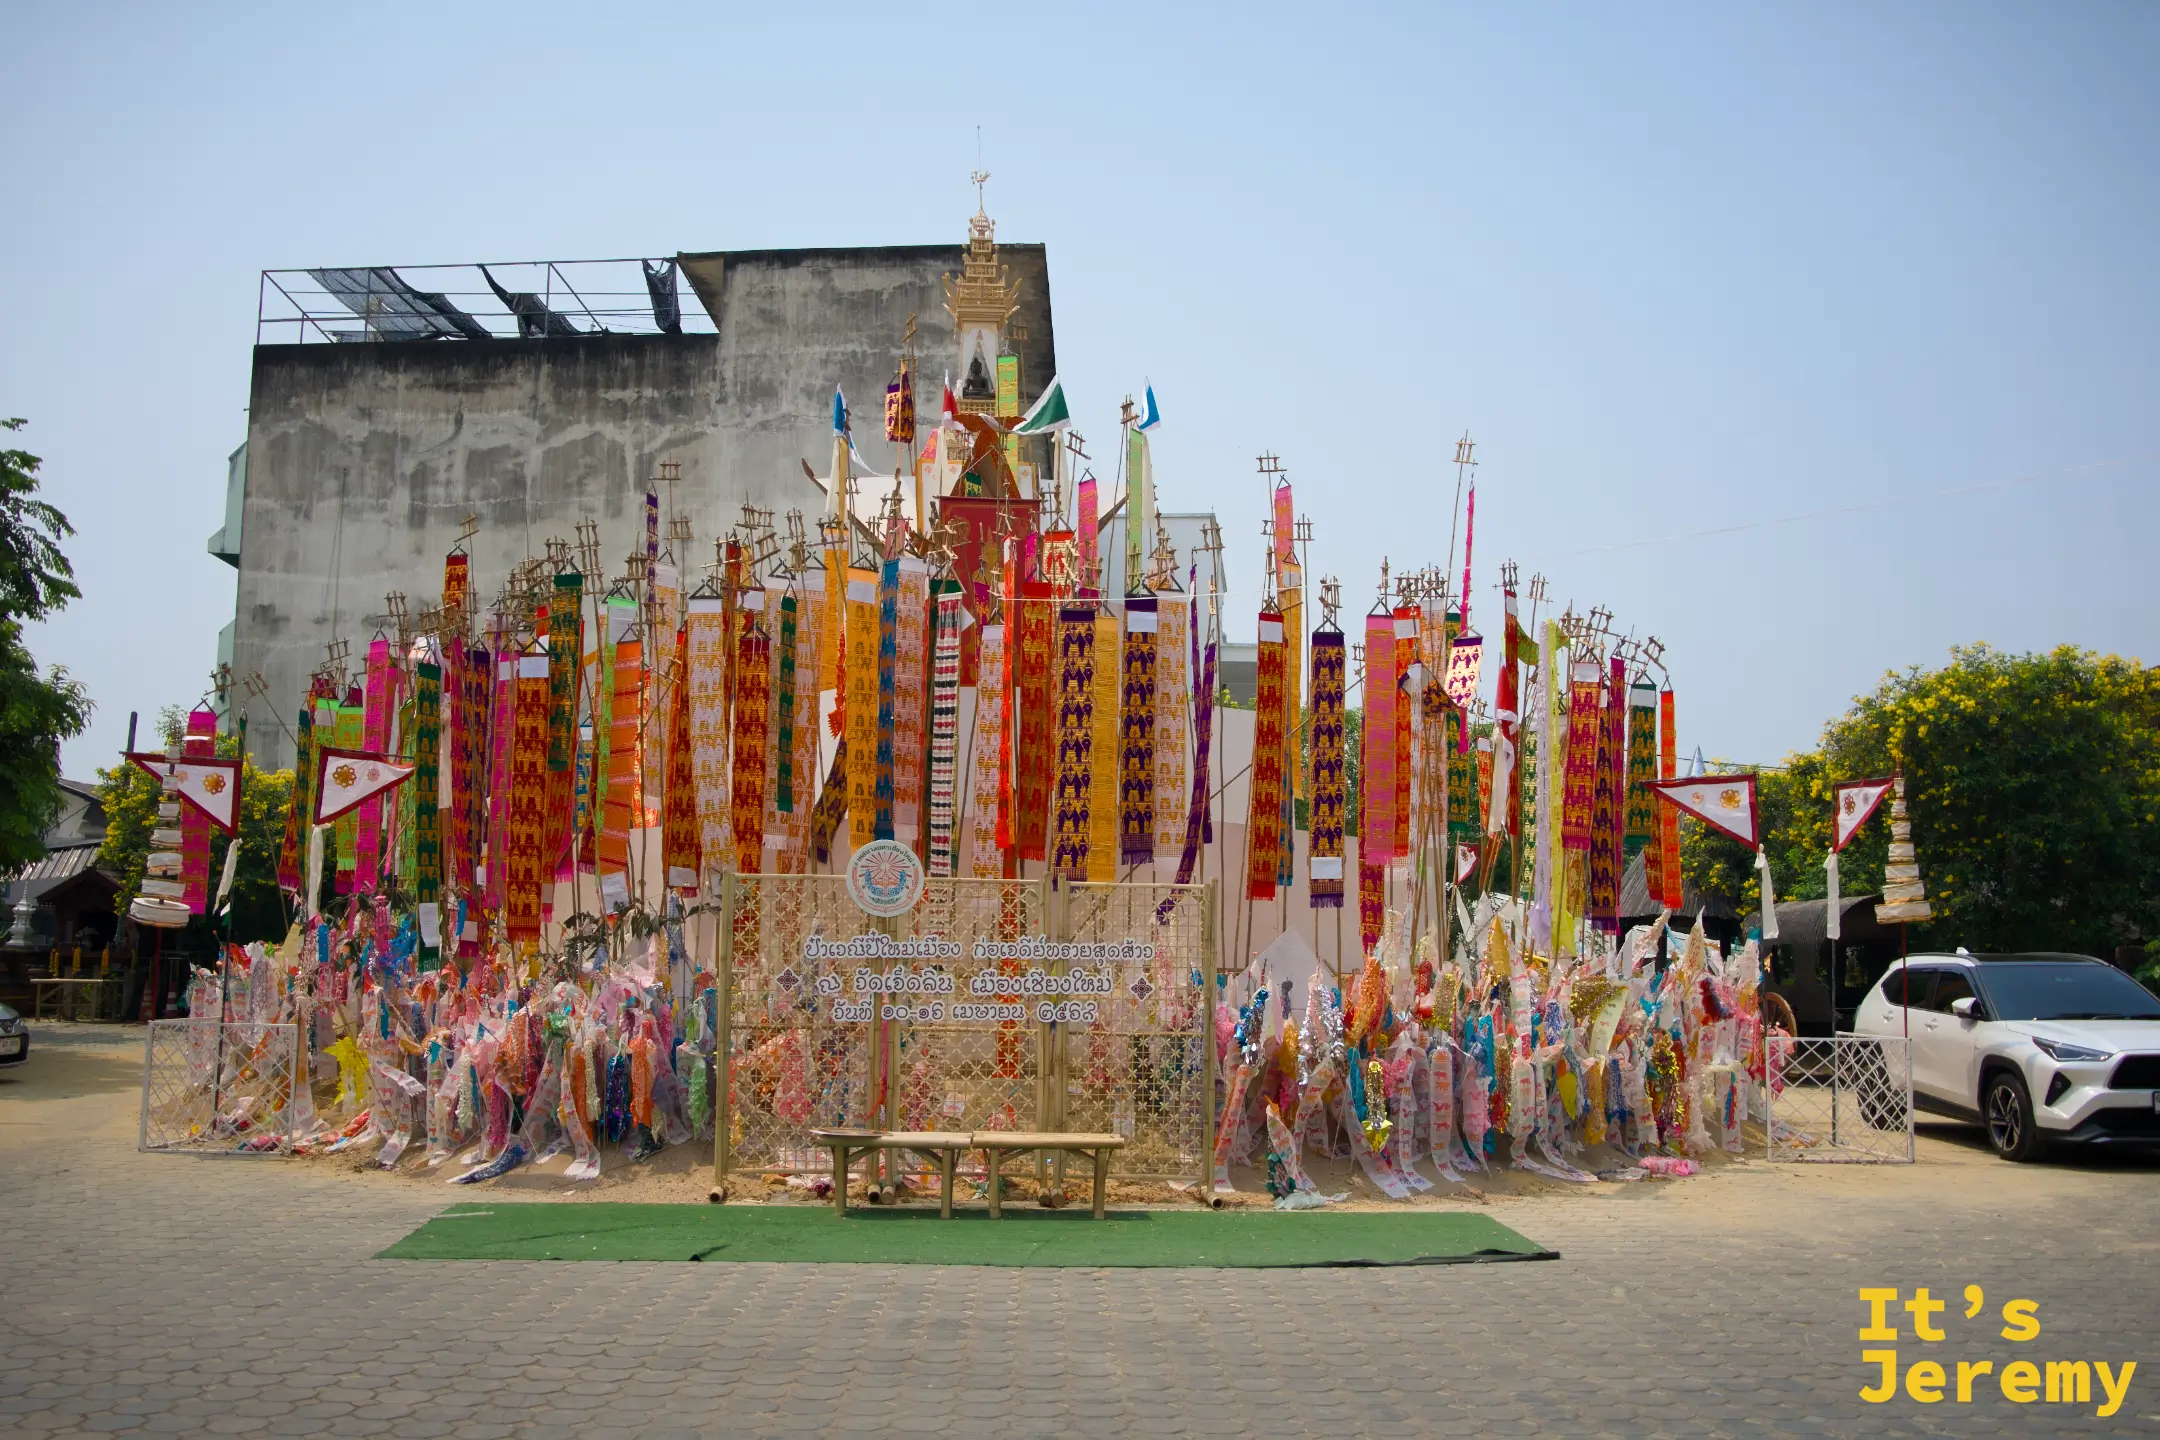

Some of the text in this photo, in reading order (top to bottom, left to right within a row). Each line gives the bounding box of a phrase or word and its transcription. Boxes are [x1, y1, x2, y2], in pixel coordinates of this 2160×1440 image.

[805, 930, 1154, 967] ป๋าเวณีปี๋ใหม่เมือง ก่อเจดีย์ทรายสุดส้าว
[818, 967, 1112, 994] ณ วัดเจ็ดลิน เมืองเชียงใหม่
[833, 995, 1097, 1021] วันที่ ๑๐-๑๖ เมษายน ๒๕๖๘
